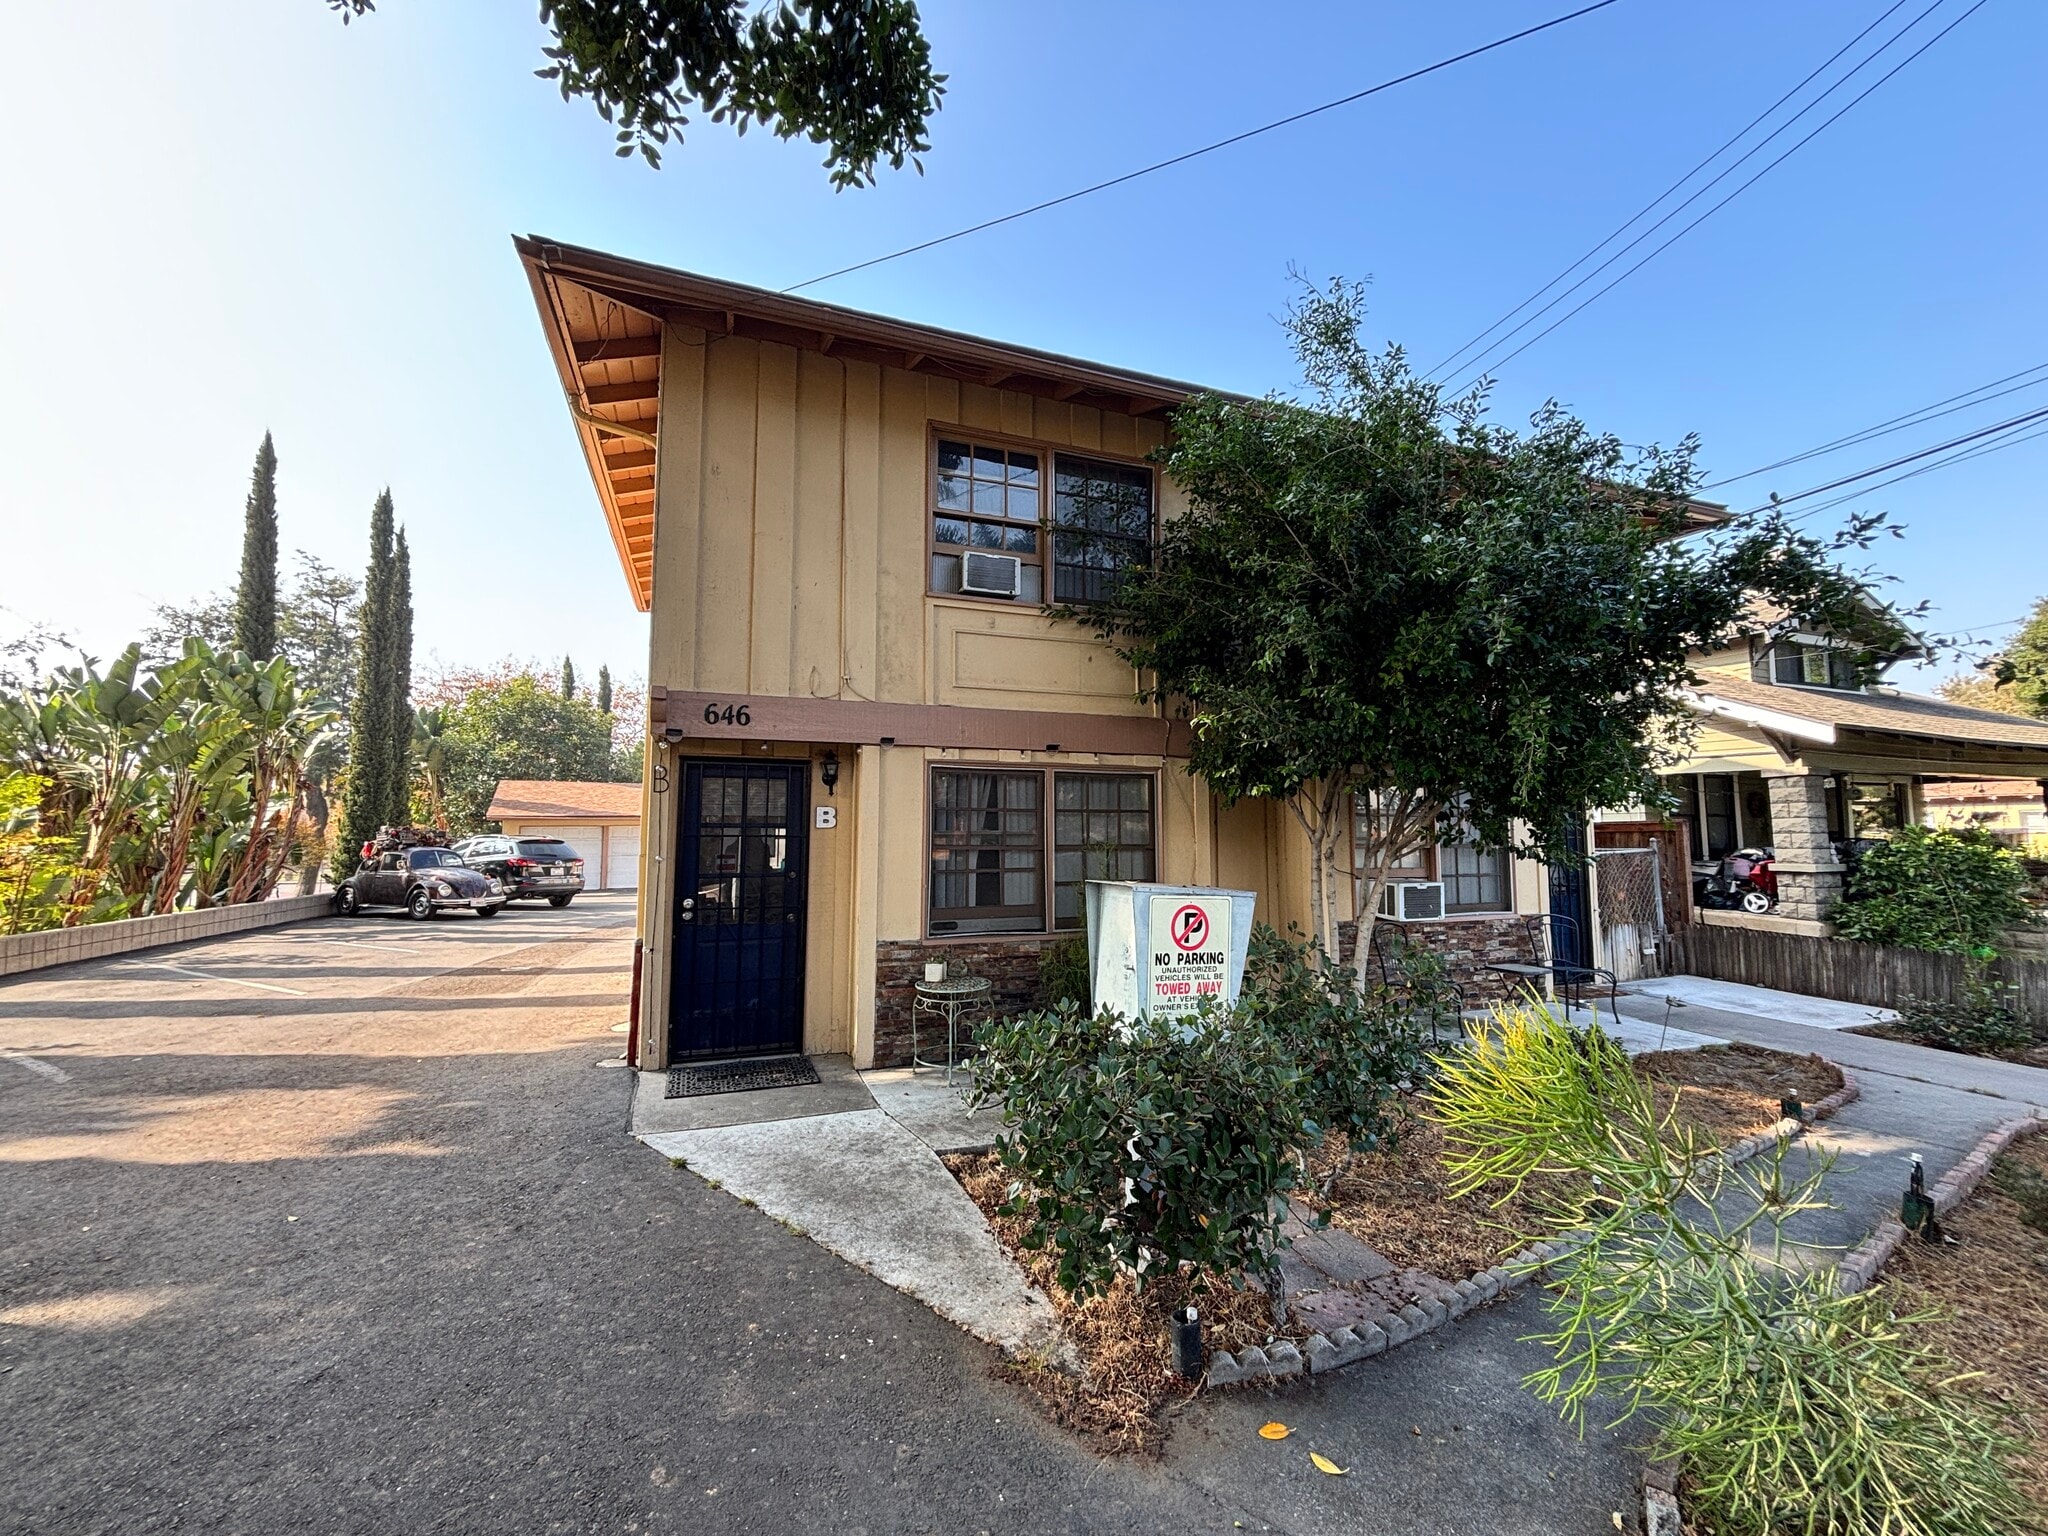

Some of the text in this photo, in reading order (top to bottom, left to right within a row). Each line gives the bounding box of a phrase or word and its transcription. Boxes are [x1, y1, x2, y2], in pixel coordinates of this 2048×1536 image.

[704, 703, 751, 726] 646
[653, 765, 670, 793] B
[816, 806, 837, 829] B
[1155, 952, 1224, 966] NO PARKING
[1162, 966, 1217, 974] UNAUTHORIZED
[1155, 974, 1191, 982] VEHICLES
[1155, 982, 1222, 995] TOWED AWAY
[1153, 1002, 1189, 1011] OWNER'S
